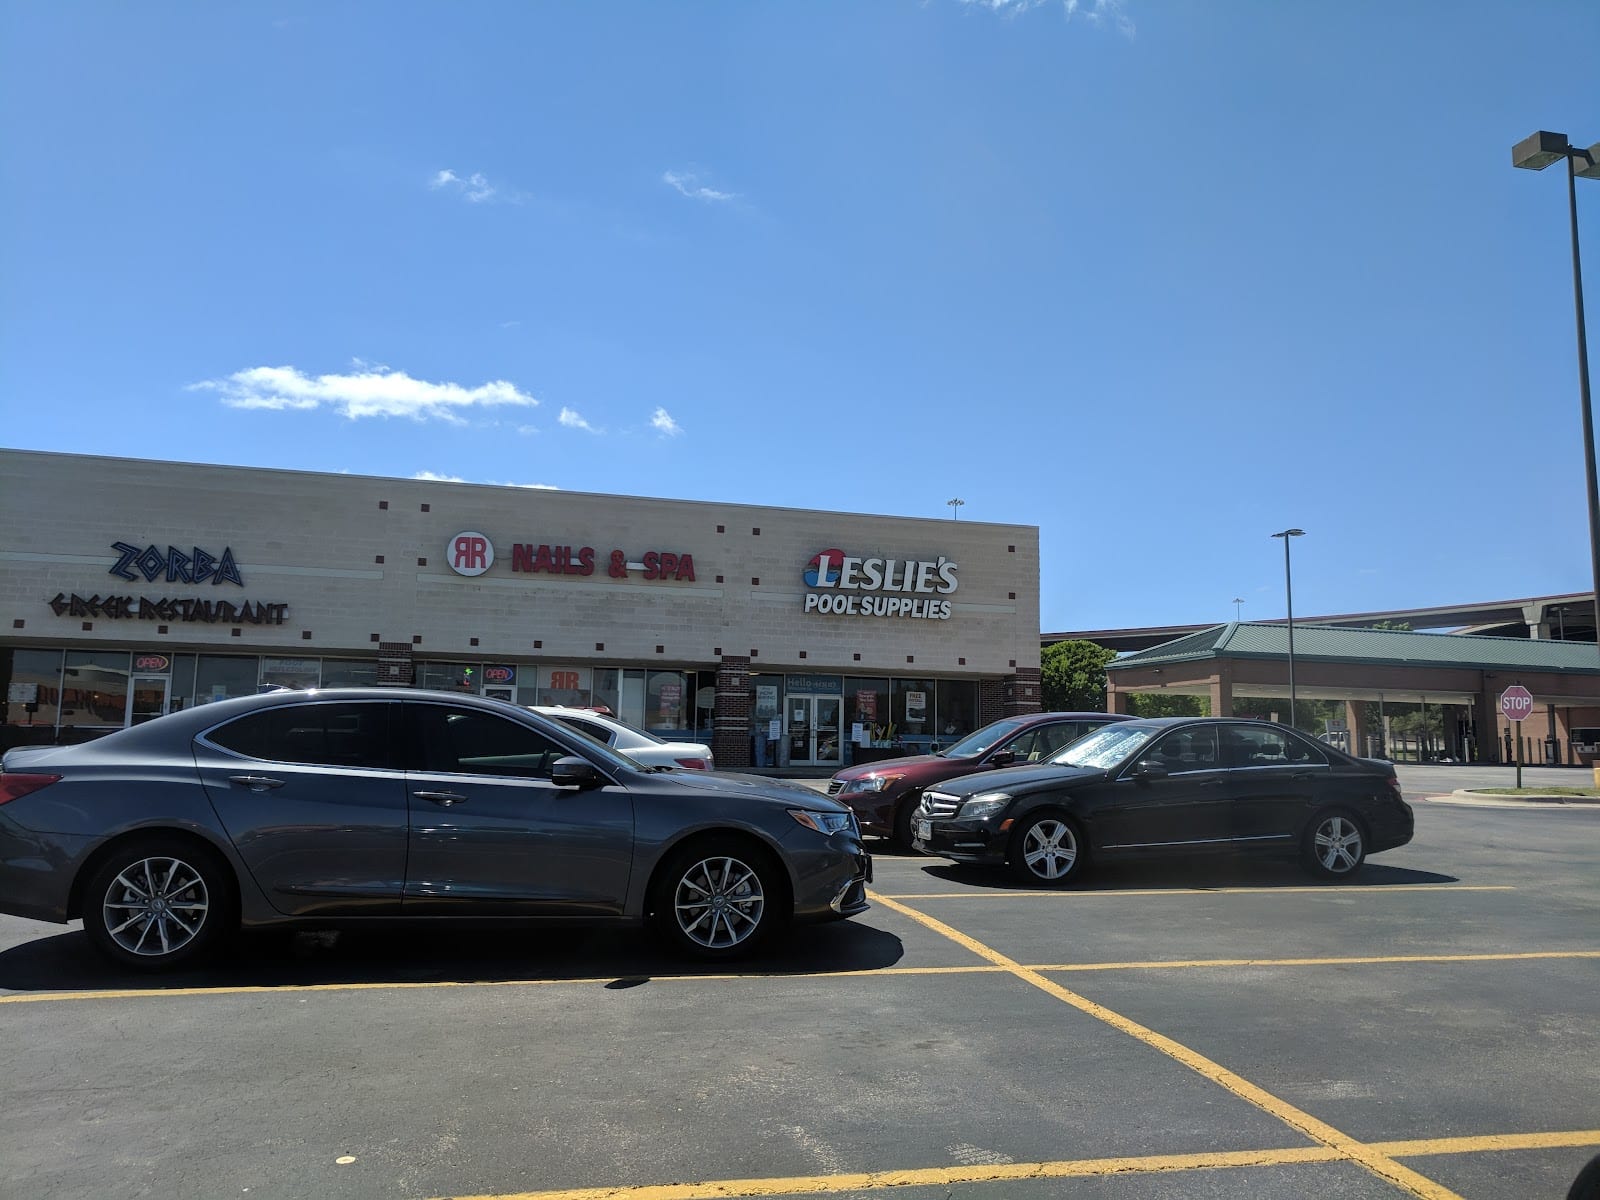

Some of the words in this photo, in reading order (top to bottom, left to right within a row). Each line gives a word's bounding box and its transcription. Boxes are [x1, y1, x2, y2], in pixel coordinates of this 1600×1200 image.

[108, 541, 244, 588] ZORBA
[512, 543, 595, 577] NAILS
[608, 549, 629, 579] &
[642, 551, 696, 582] SPA
[815, 555, 959, 595] LESLIE'S
[48, 592, 134, 620] GREEK
[138, 596, 289, 626] RESTAURANT
[804, 593, 858, 615] POOL
[859, 597, 952, 621] SUPPLIES
[136, 656, 165, 669] OPEN
[486, 668, 508, 679] OPEN
[787, 677, 812, 687] Hello
[1503, 696, 1531, 710] STOP
